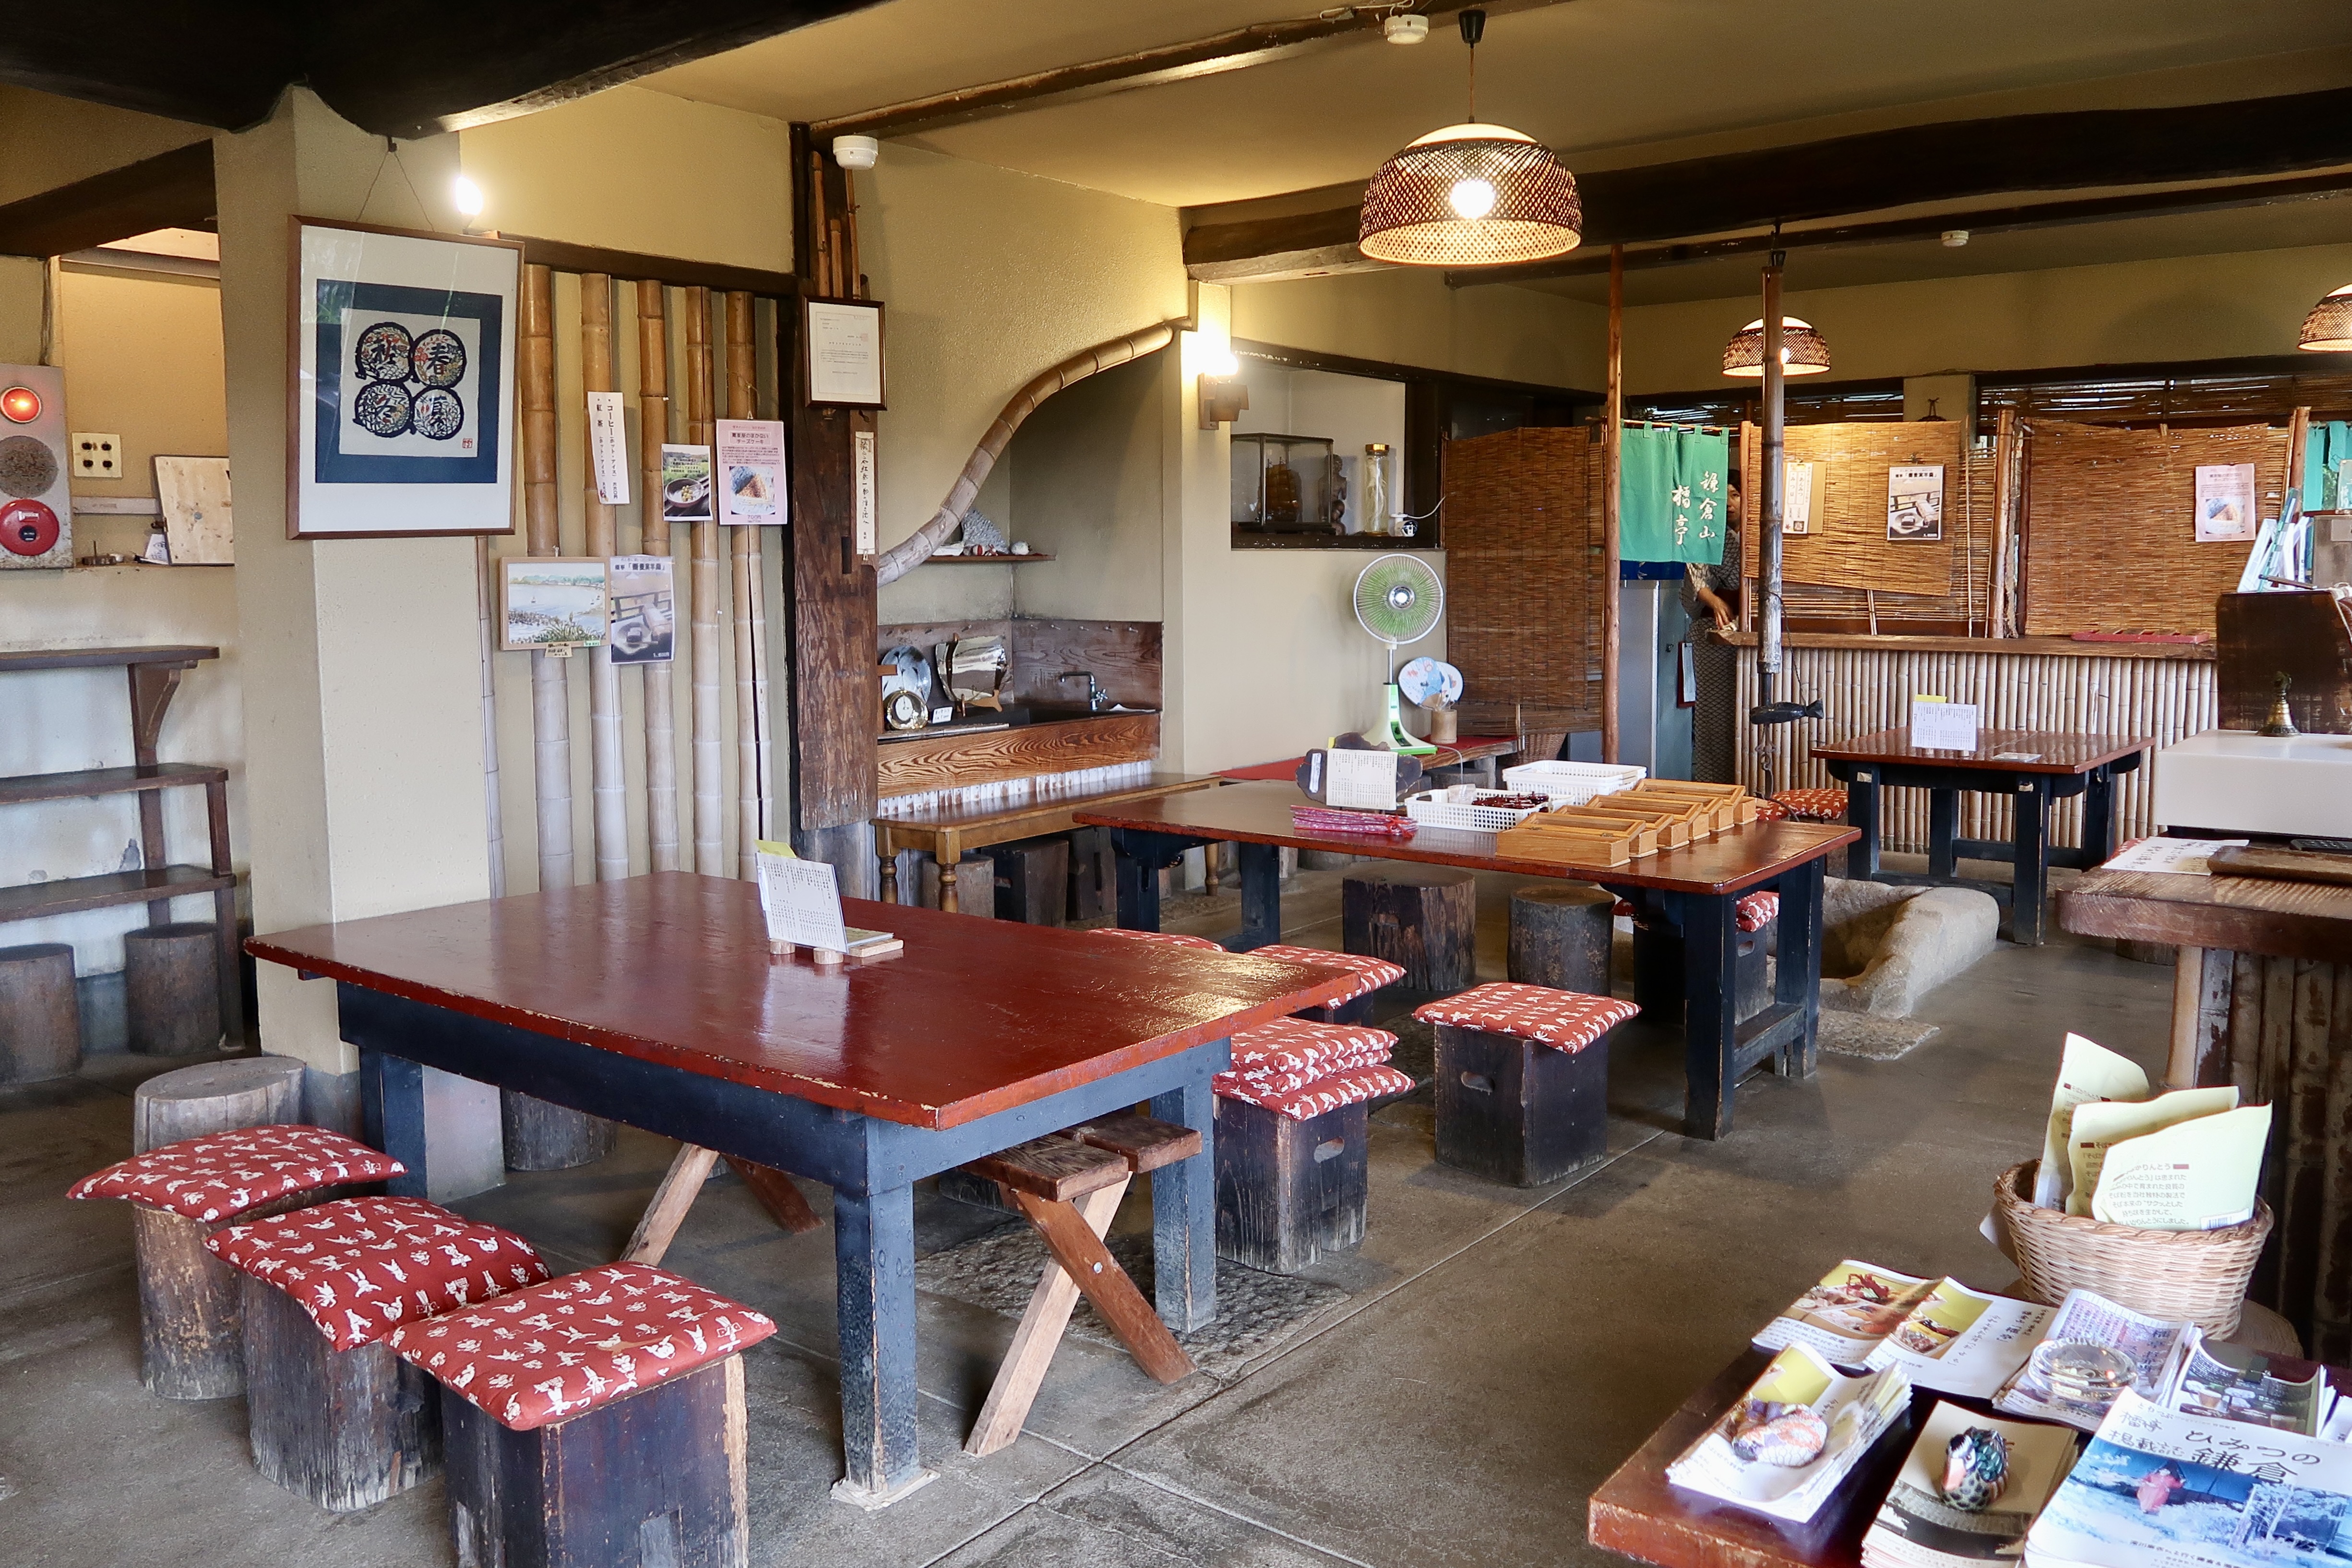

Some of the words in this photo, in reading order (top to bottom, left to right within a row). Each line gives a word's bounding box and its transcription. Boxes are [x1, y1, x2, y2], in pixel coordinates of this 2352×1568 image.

[1699, 470, 1719, 539] 鎌倉山
[2185, 1430, 2321, 1465] ひみつの
[2191, 1448, 2299, 1484] 鎌倉
